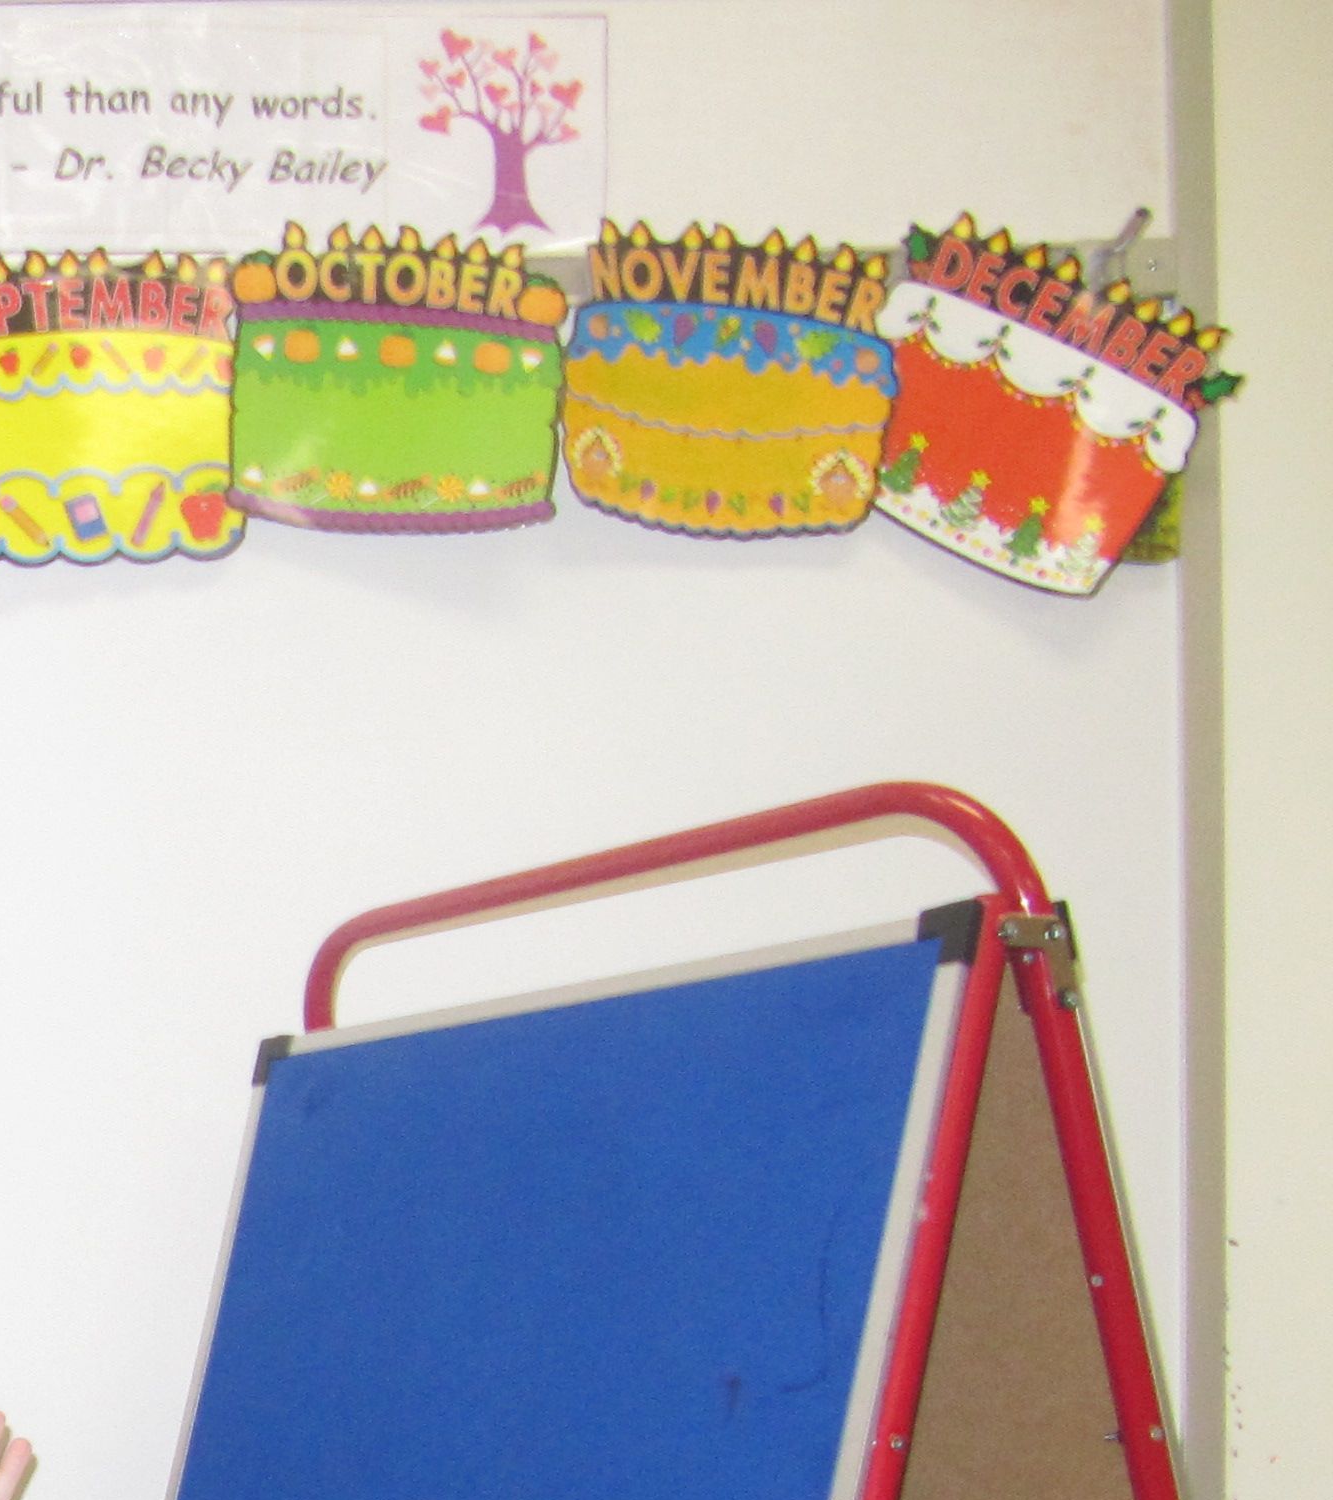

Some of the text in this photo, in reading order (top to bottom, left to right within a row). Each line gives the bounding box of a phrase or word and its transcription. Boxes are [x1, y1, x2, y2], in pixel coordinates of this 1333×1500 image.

[64, 80, 150, 114] than
[170, 91, 234, 127] any
[252, 86, 375, 119] words.
[55, 146, 112, 180] Dr.
[141, 144, 253, 193] Becky
[268, 148, 389, 192] Bailey
[274, 248, 525, 316] OCTOBER
[588, 246, 887, 332] NOVEMBER
[932, 236, 1208, 398] DECEMBER
